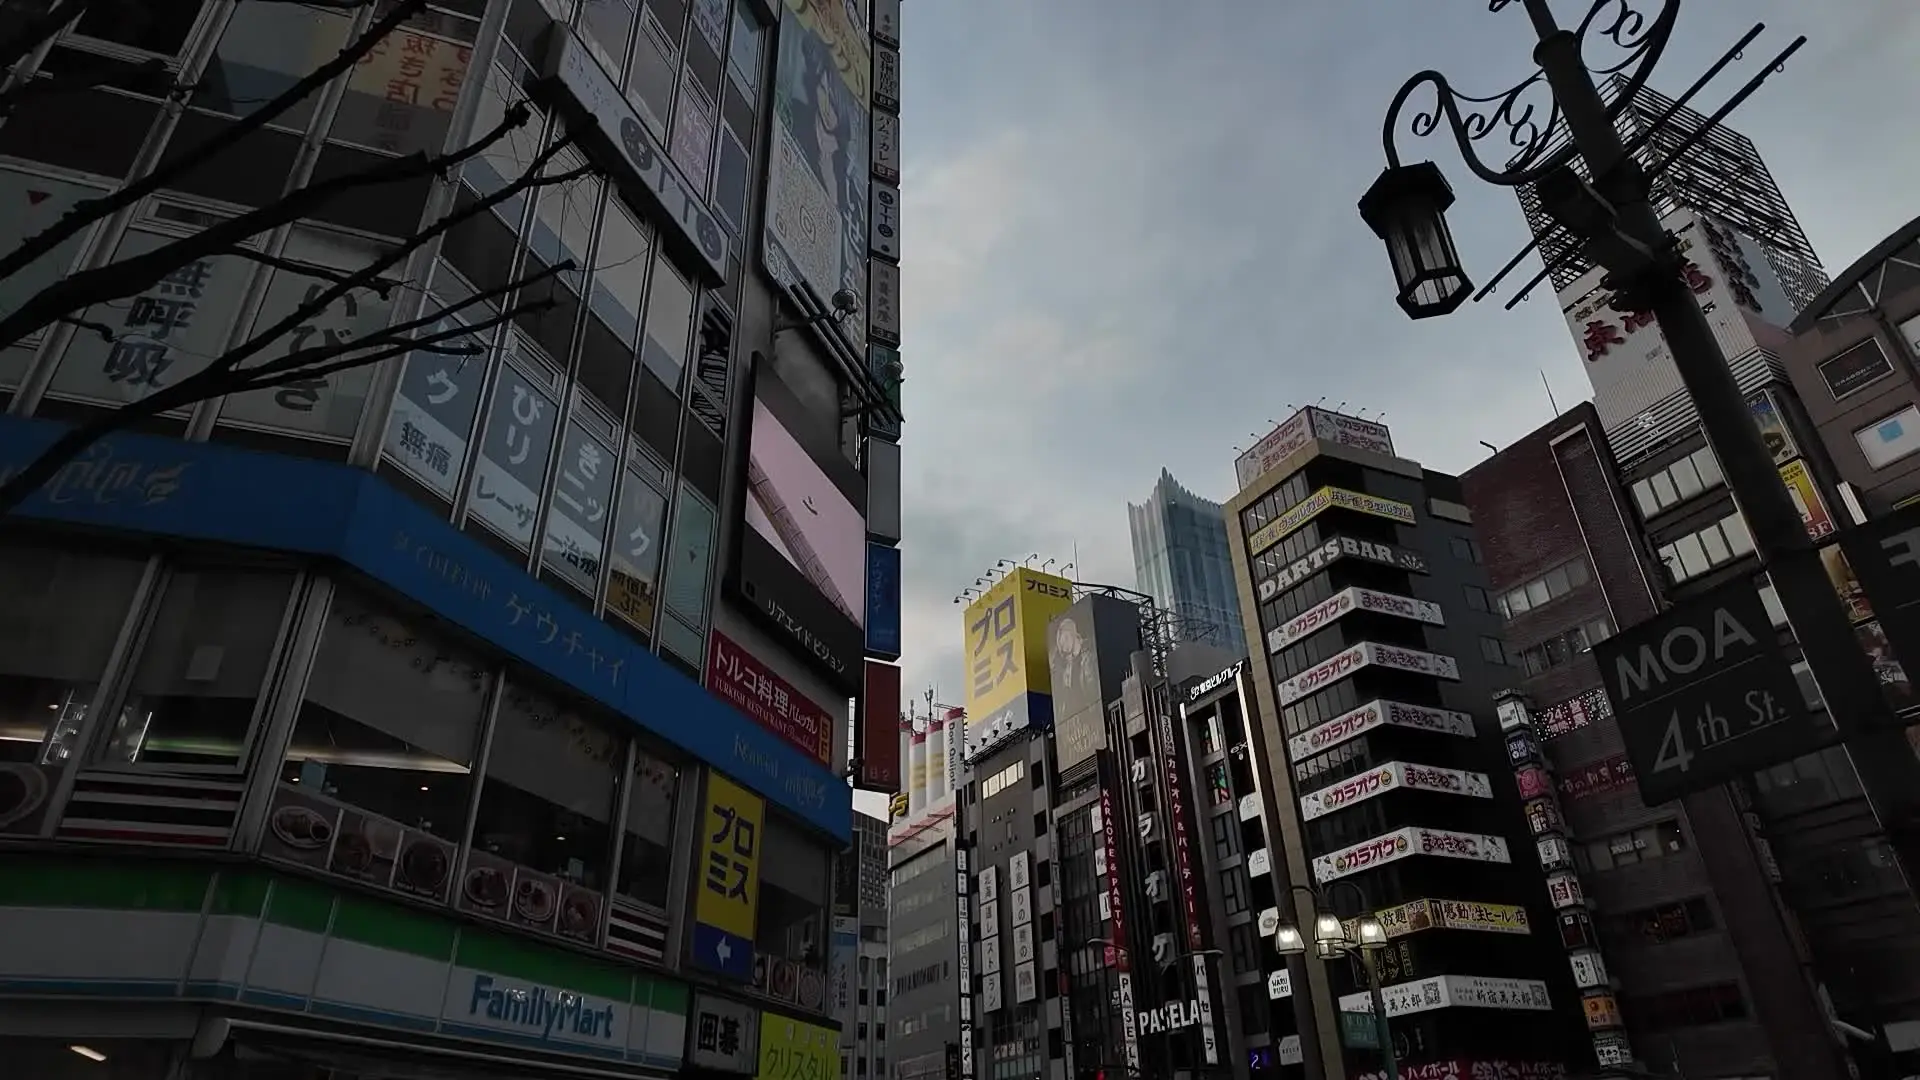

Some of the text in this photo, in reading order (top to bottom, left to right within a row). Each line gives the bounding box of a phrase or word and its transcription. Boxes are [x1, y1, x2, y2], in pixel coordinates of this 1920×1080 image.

[1026, 580, 1069, 600] プロミス
[1259, 537, 1395, 601] DARTS BAR
[505, 590, 625, 688] ゲウチャイ
[767, 599, 847, 673] リアエイドビジョン
[1296, 598, 1341, 631] カラオケ
[716, 642, 789, 719] トルコ料理
[1307, 654, 1351, 687] カラオケ
[1616, 607, 1757, 701] MOA
[715, 675, 746, 704] TURKISH
[1320, 713, 1366, 746] カラオケ
[1653, 702, 1730, 773] 4th
[1745, 690, 1786, 726] St.
[1332, 773, 1381, 806] カラオケ
[1102, 788, 1116, 857] KARAOKE
[1112, 878, 1122, 929] PARTY
[1345, 837, 1397, 869] カラオケ
[470, 974, 614, 1041] FamilyMart
[698, 1012, 740, 1056] 囲碁
[1121, 977, 1140, 1075] PASELA
[1139, 1000, 1201, 1037] PASELA
